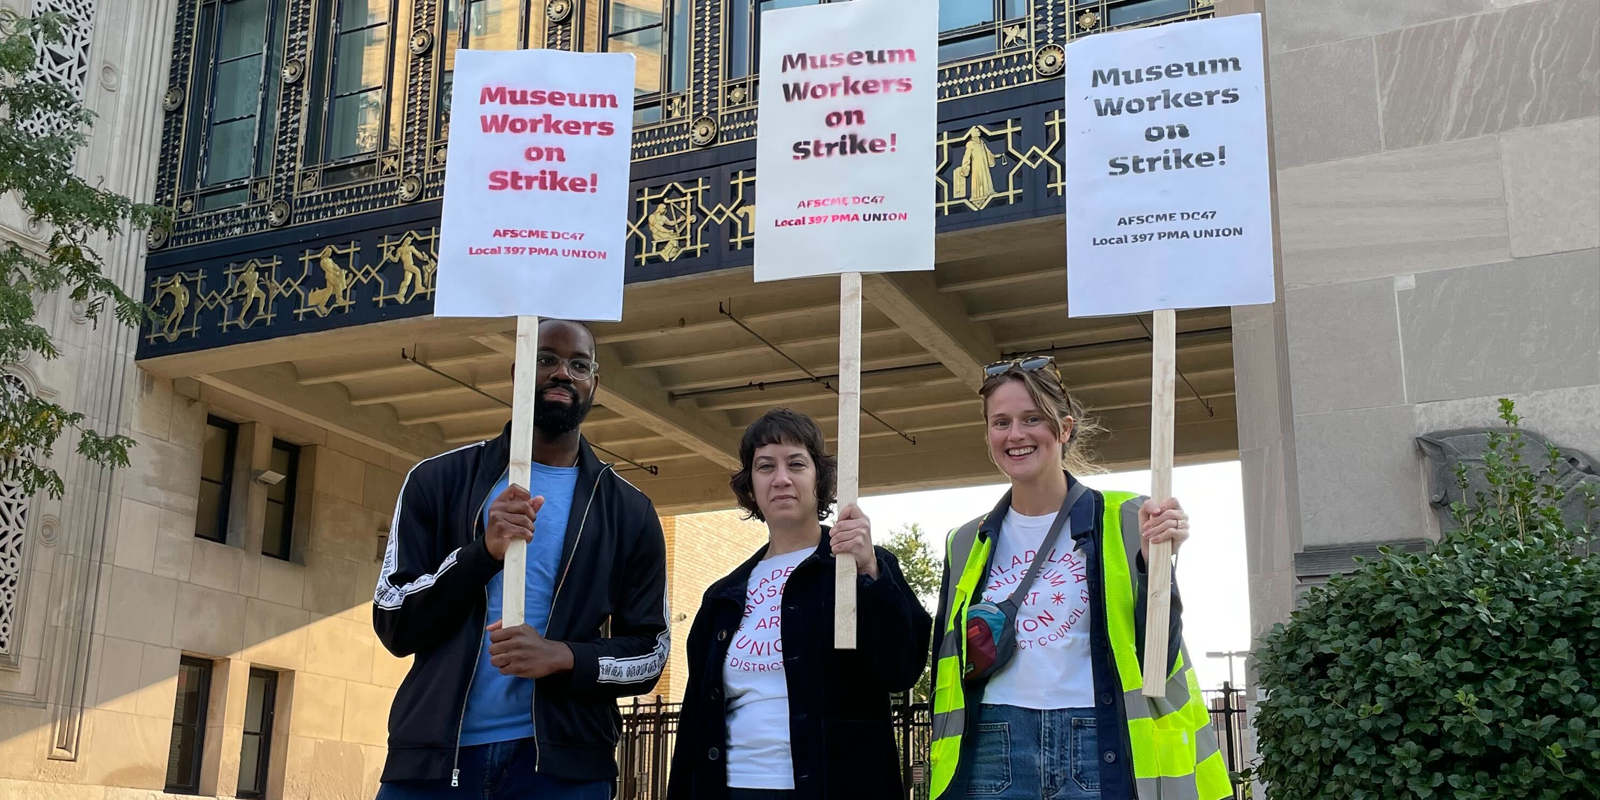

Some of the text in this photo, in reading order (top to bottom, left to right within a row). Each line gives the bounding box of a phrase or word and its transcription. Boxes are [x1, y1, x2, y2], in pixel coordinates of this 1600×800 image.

[781, 48, 916, 73] Museum
[1091, 56, 1242, 88] Museum
[479, 86, 619, 108] Museum
[782, 75, 913, 103] Workers
[1093, 87, 1240, 117] Workers
[479, 113, 615, 136] Workers
[825, 109, 866, 127] on
[1144, 123, 1190, 142] on
[524, 145, 566, 162] on
[792, 133, 898, 161] Strike!
[1108, 145, 1227, 176] Strike!
[488, 169, 598, 193] Strike!
[797, 195, 885, 209] AFSCME DC47
[774, 212, 908, 227] Local 397 PMA UNION
[1117, 210, 1217, 226] AFSCME DC47
[492, 228, 585, 241] AFSCME DC47
[1092, 227, 1243, 246] Local 397 PMA UNION
[468, 246, 607, 260] Local 397 PMA UNION
[1023, 591, 1040, 606] RT
[755, 615, 781, 630] AR
[1015, 609, 1055, 633] ION
[1037, 608, 1086, 647] COUNCIL
